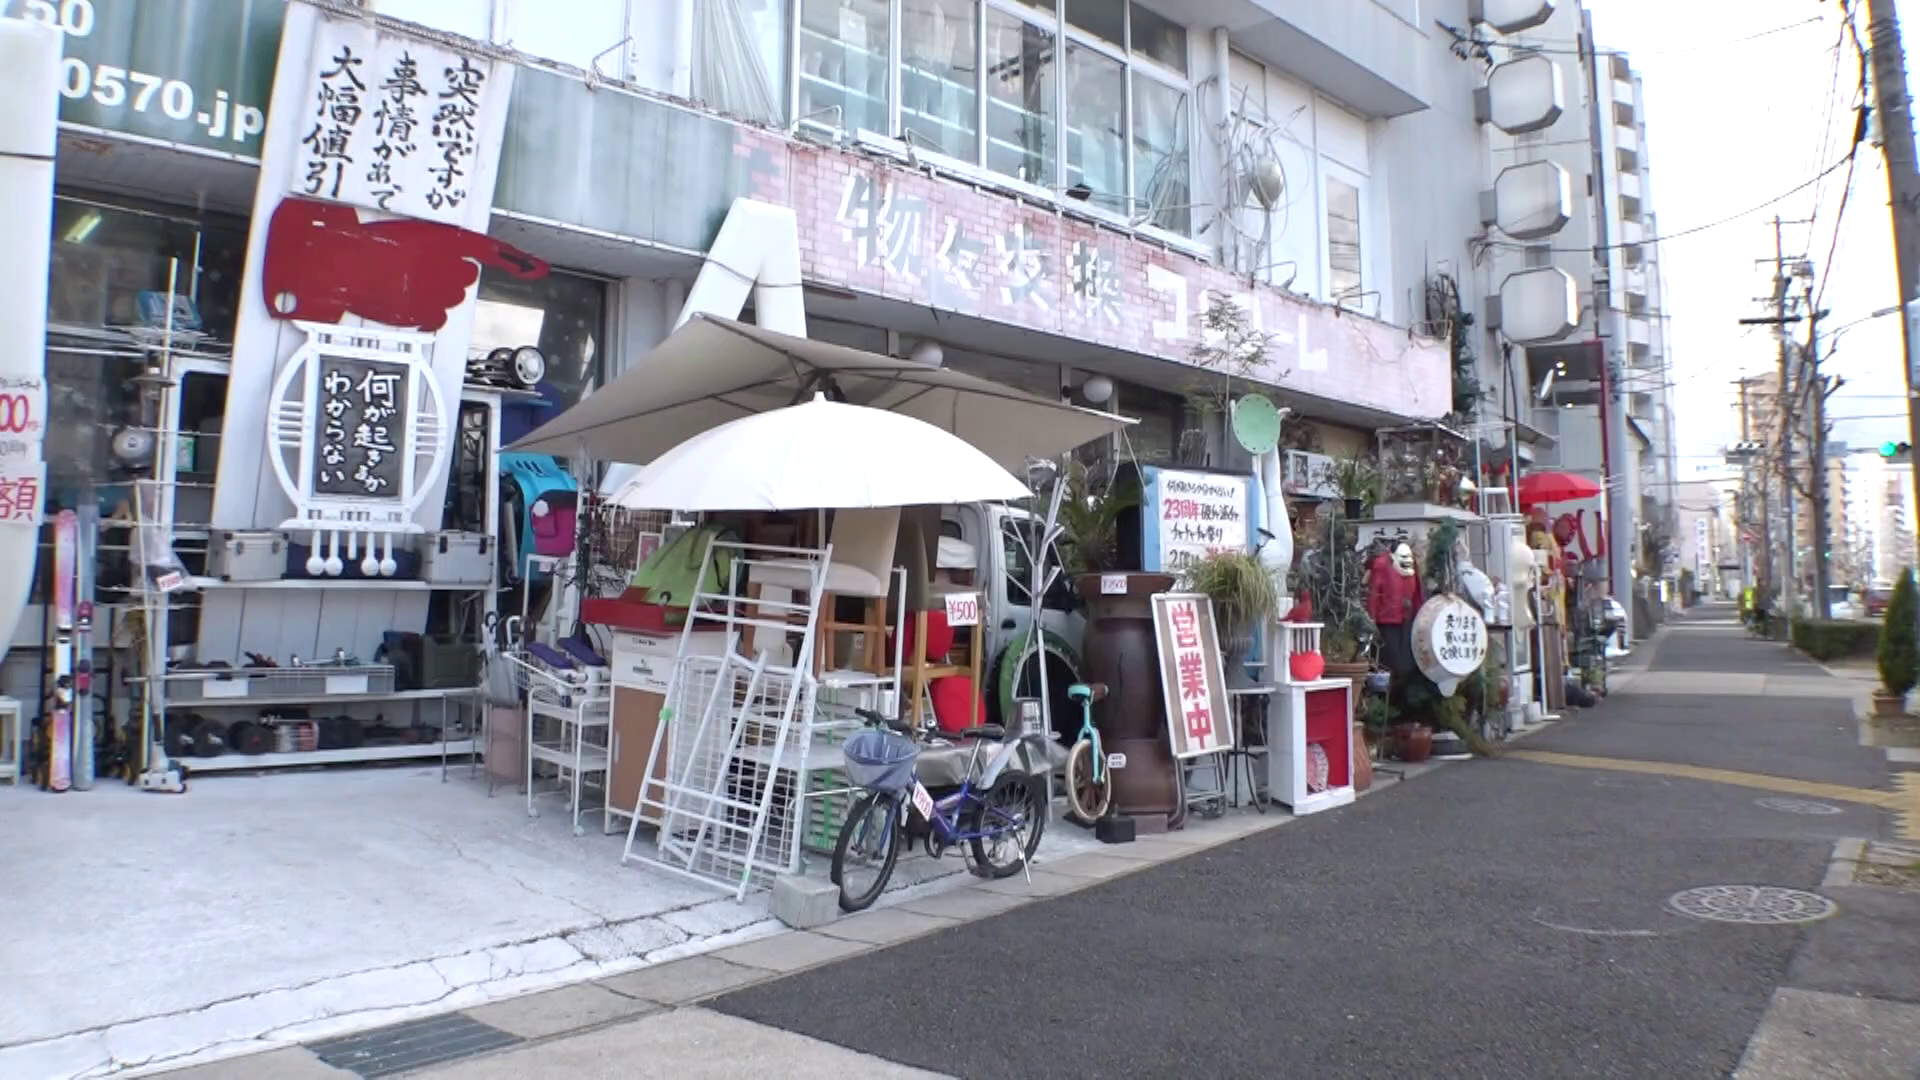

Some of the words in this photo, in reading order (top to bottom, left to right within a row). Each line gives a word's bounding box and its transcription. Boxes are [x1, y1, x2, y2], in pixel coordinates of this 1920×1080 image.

[303, 45, 367, 199] 大幅値引
[426, 57, 486, 210] 突然ですが
[319, 370, 353, 484] わからない
[947, 600, 977, 620] ¥500
[1170, 602, 1213, 750] 営業中
